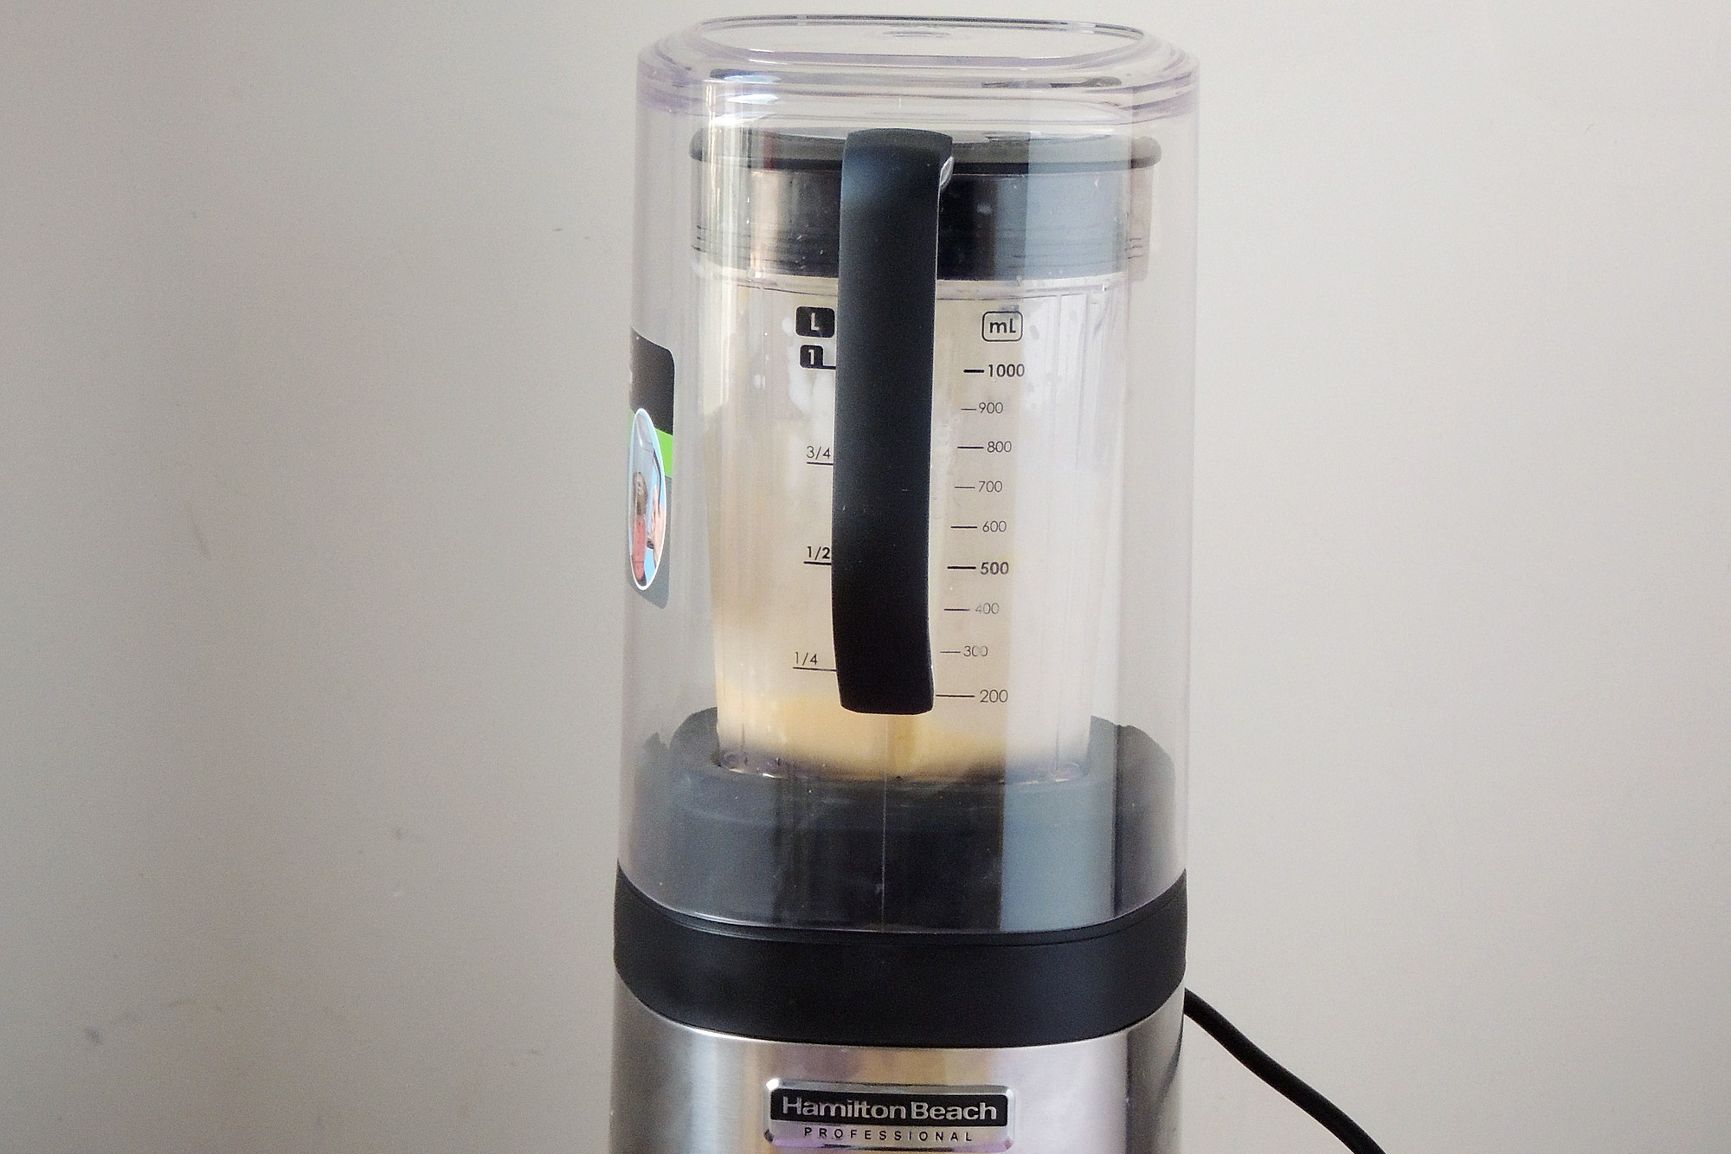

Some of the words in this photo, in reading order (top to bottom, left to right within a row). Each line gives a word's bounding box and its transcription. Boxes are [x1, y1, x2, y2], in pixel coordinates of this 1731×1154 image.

[810, 312, 820, 331] L
[989, 318, 1017, 334] mL
[807, 349, 815, 365] 1
[988, 363, 1025, 378] 1000
[978, 402, 1004, 414] 900
[806, 445, 831, 460] 3/4
[987, 440, 1012, 453] 800
[978, 480, 1003, 493] 700
[982, 520, 1007, 533] 600
[807, 546, 831, 560] 1/2
[980, 561, 1009, 575] 500
[975, 602, 1000, 615] 400
[795, 651, 818, 666] 1/4
[963, 645, 988, 658] 300
[979, 689, 1008, 703] 200
[781, 1096, 906, 1120] Hamilton
[910, 1101, 997, 1120] Beach
[804, 1127, 972, 1142] PROFESSIONAL
